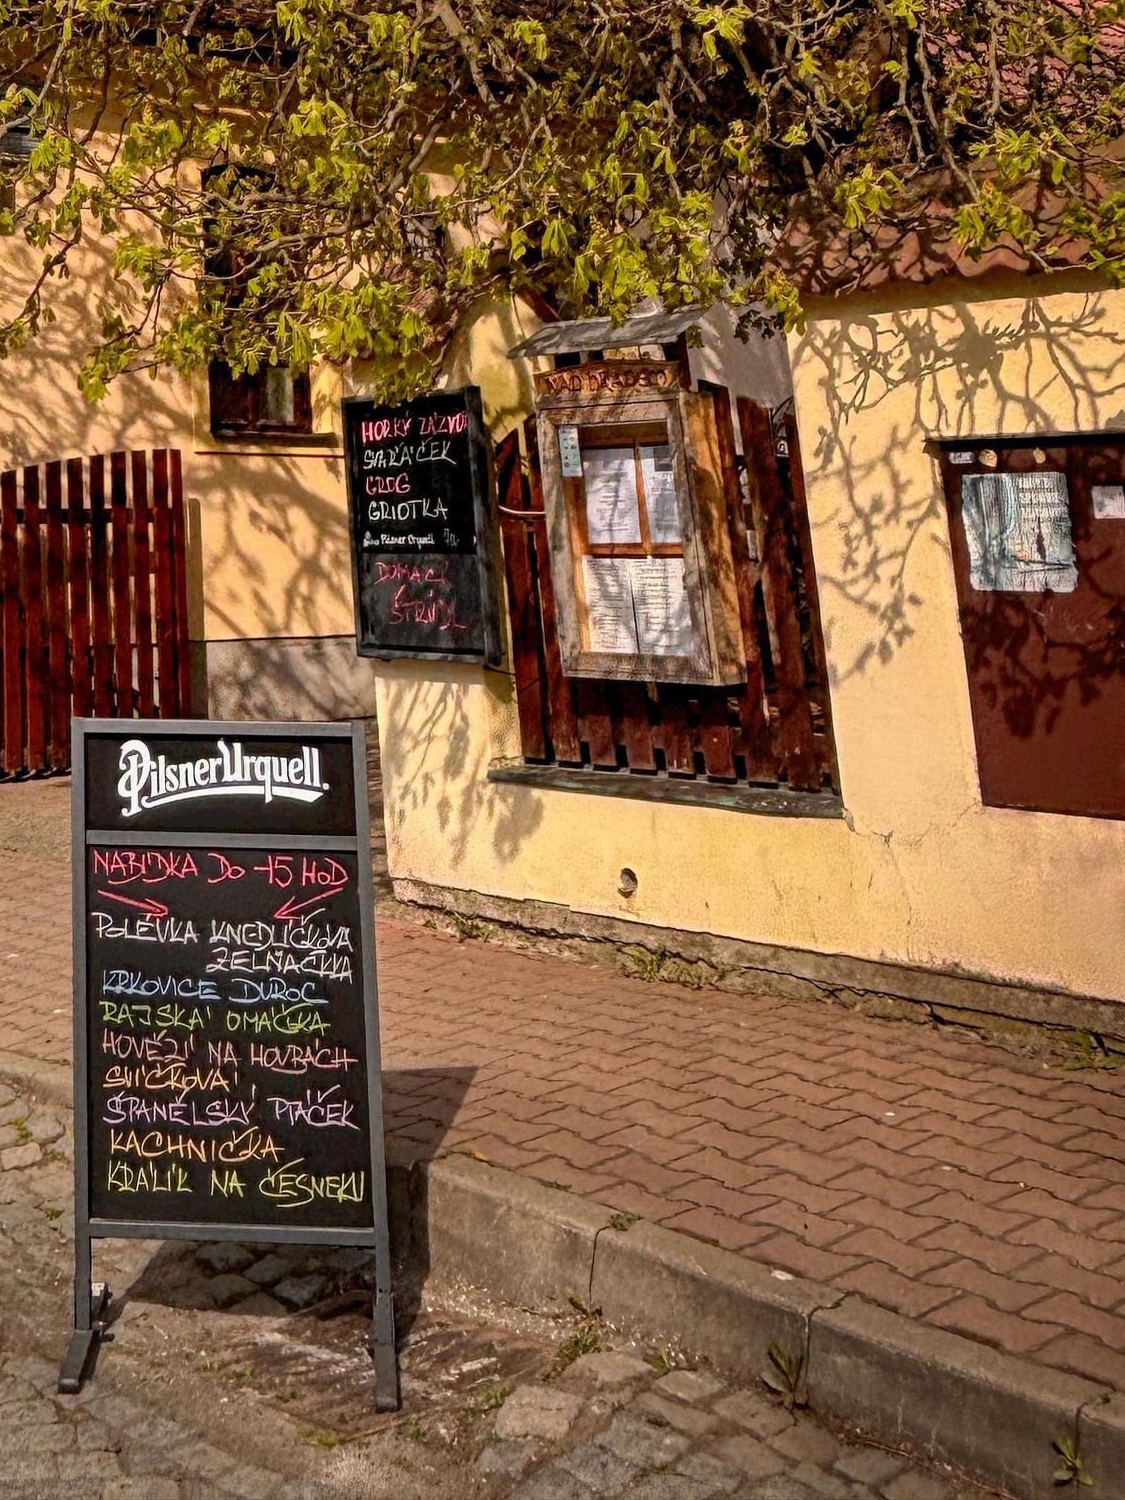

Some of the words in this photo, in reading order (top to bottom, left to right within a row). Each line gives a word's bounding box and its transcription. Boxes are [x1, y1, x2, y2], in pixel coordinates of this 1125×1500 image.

[366, 472, 411, 496] GROG
[368, 497, 448, 520] GRIOTKA
[117, 739, 221, 817] Pilsner
[93, 850, 199, 885] NABÍDKA
[207, 852, 246, 884] DO
[91, 911, 201, 945] POLÉVKA
[103, 969, 222, 1000] KRKOVICE
[228, 976, 330, 1004] DUROC
[98, 1000, 211, 1031] RAJSKÁ
[226, 1002, 332, 1037] OMÁČKA
[102, 1027, 195, 1063] HOVĚZÍ
[207, 1040, 242, 1068] NA
[103, 1062, 239, 1093] SVÍČKOVÁ
[102, 1084, 257, 1127] ŠPANĚLSKÝ
[266, 1083, 362, 1132] PTÁČEK
[111, 1126, 286, 1164] KACHNIČKA
[107, 1160, 193, 1193] KRÁLÍK
[210, 1169, 246, 1198] NA
[258, 1157, 365, 1208] ČESNEKU
